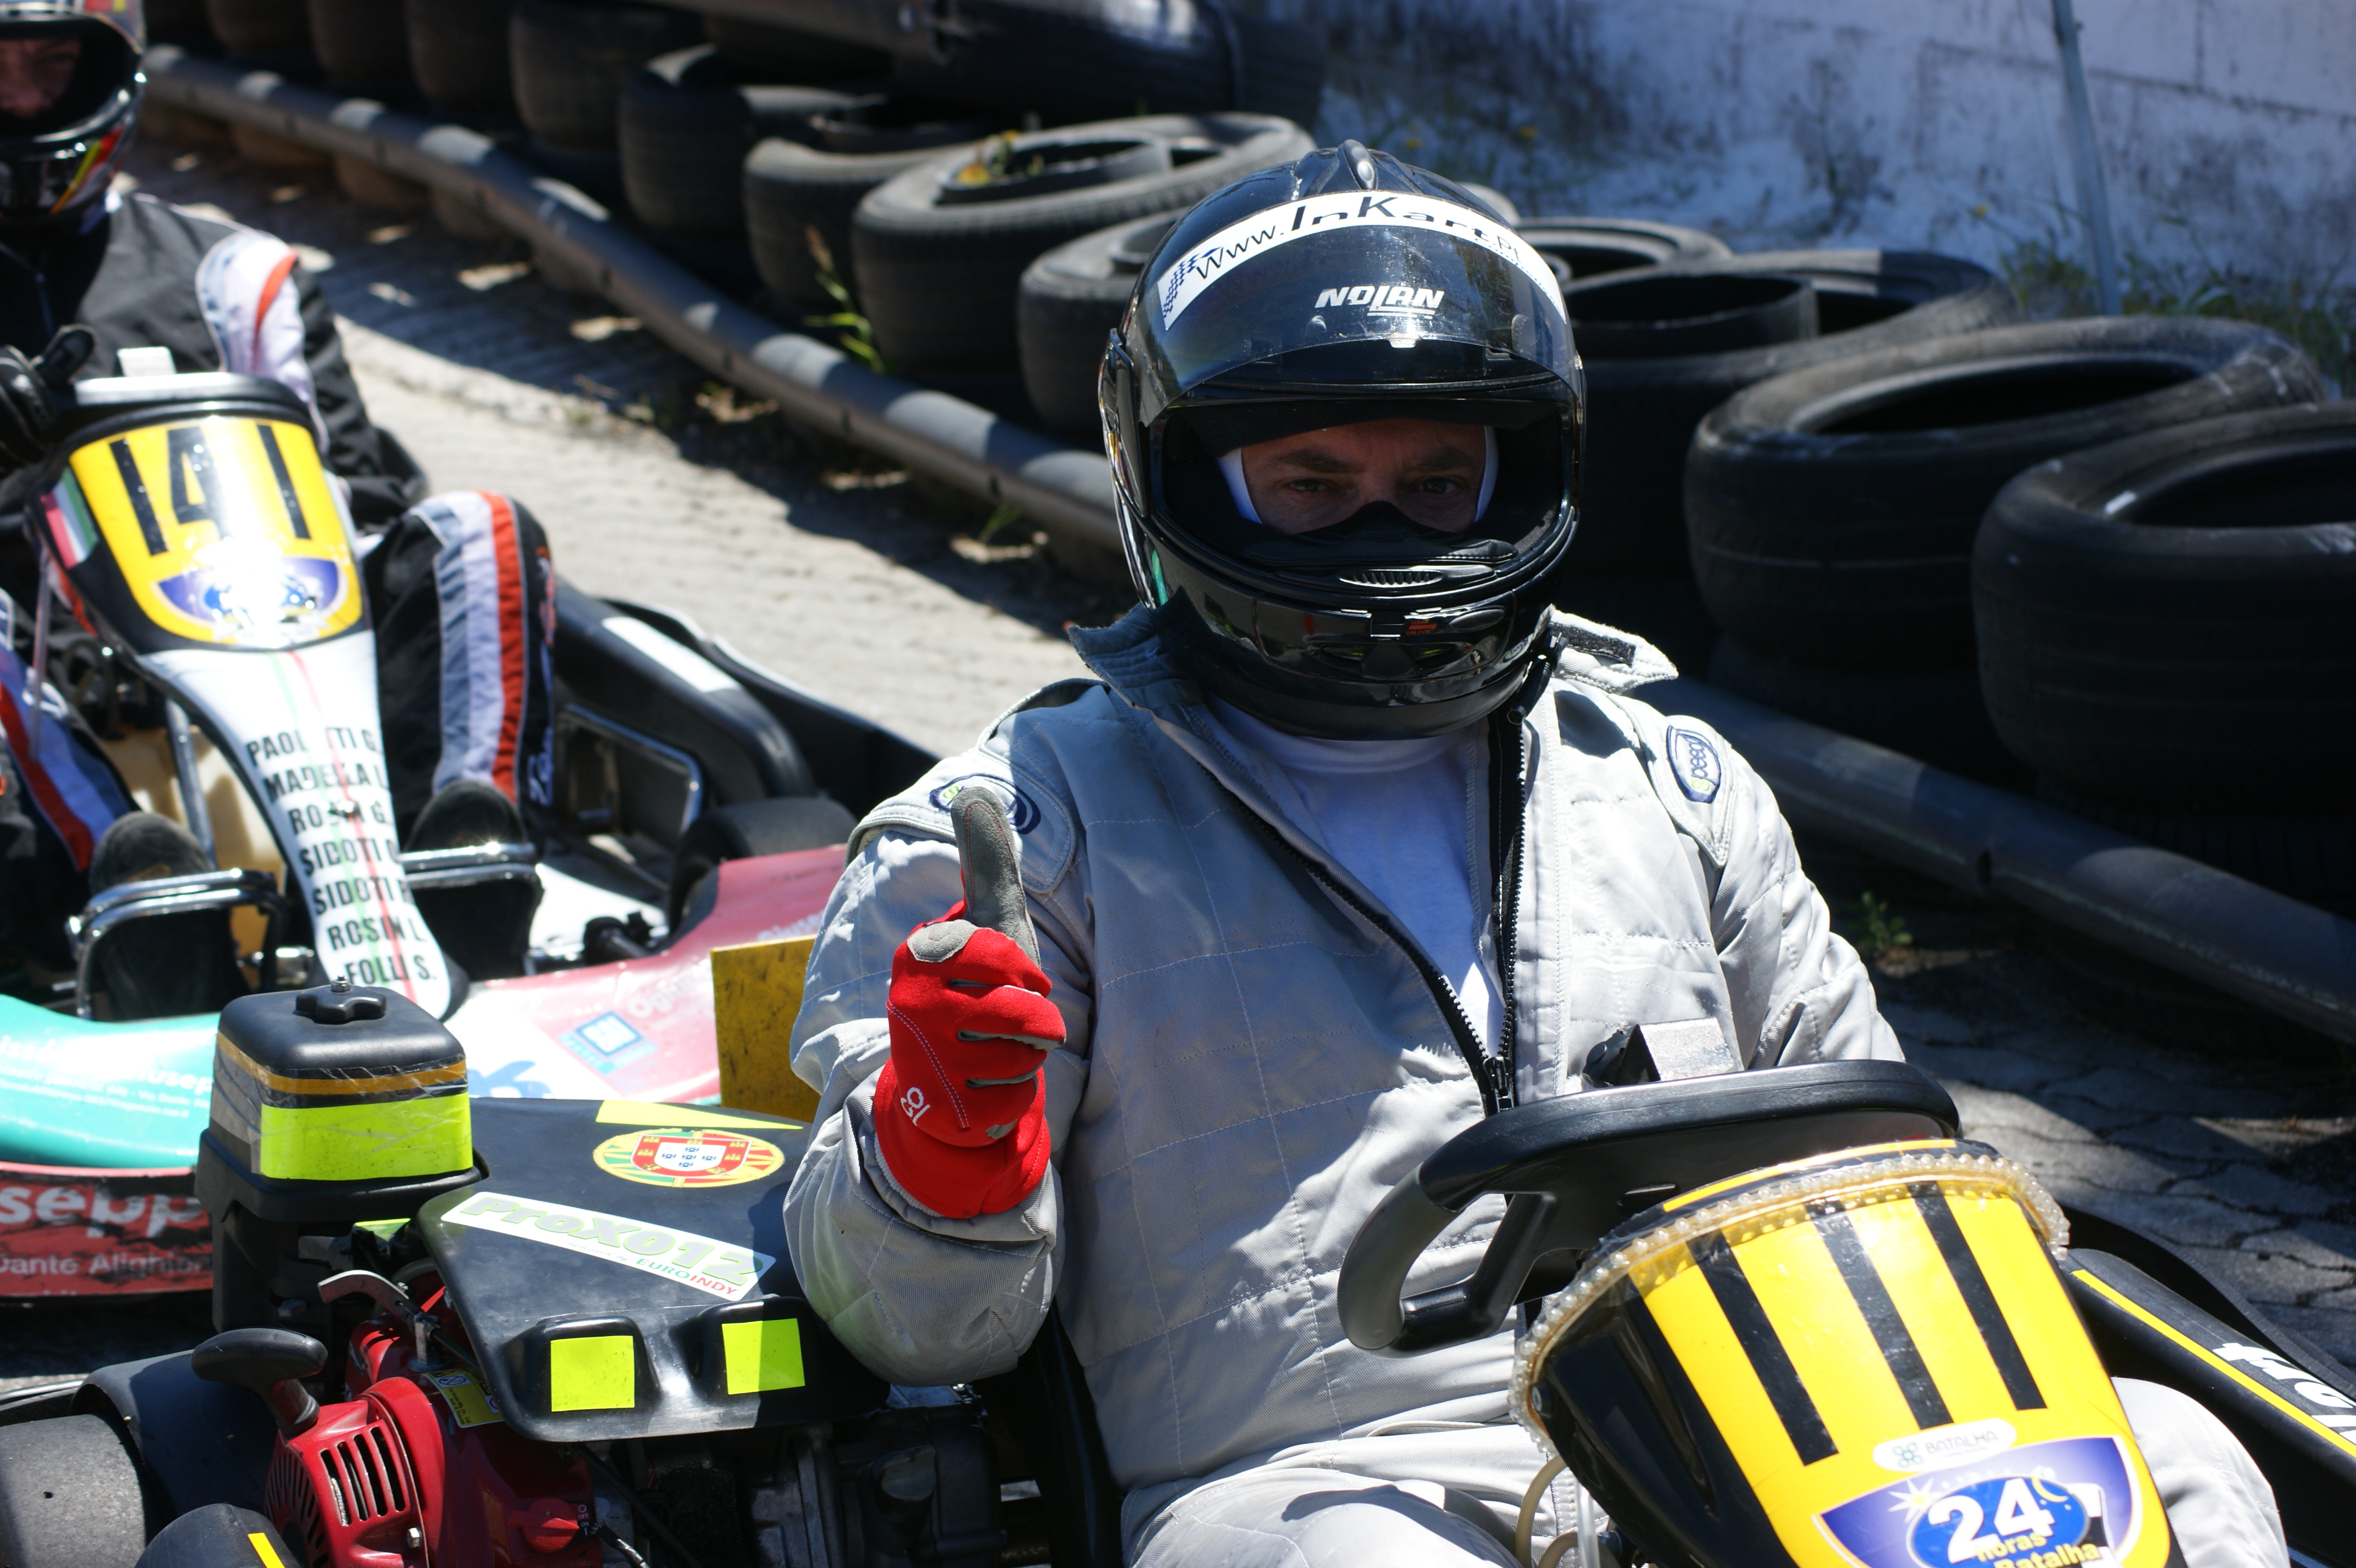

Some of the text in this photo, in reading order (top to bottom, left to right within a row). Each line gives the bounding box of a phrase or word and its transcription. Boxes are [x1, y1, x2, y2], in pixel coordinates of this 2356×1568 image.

[1314, 285, 1445, 316] NOLAN
[246, 727, 357, 768] PAOLTTI
[636, 1258, 738, 1295] EUROINDY
[1925, 1430, 1998, 1454] BATALHA
[1927, 1478, 2055, 1564] 24
[1974, 1532, 2048, 1563] horas
